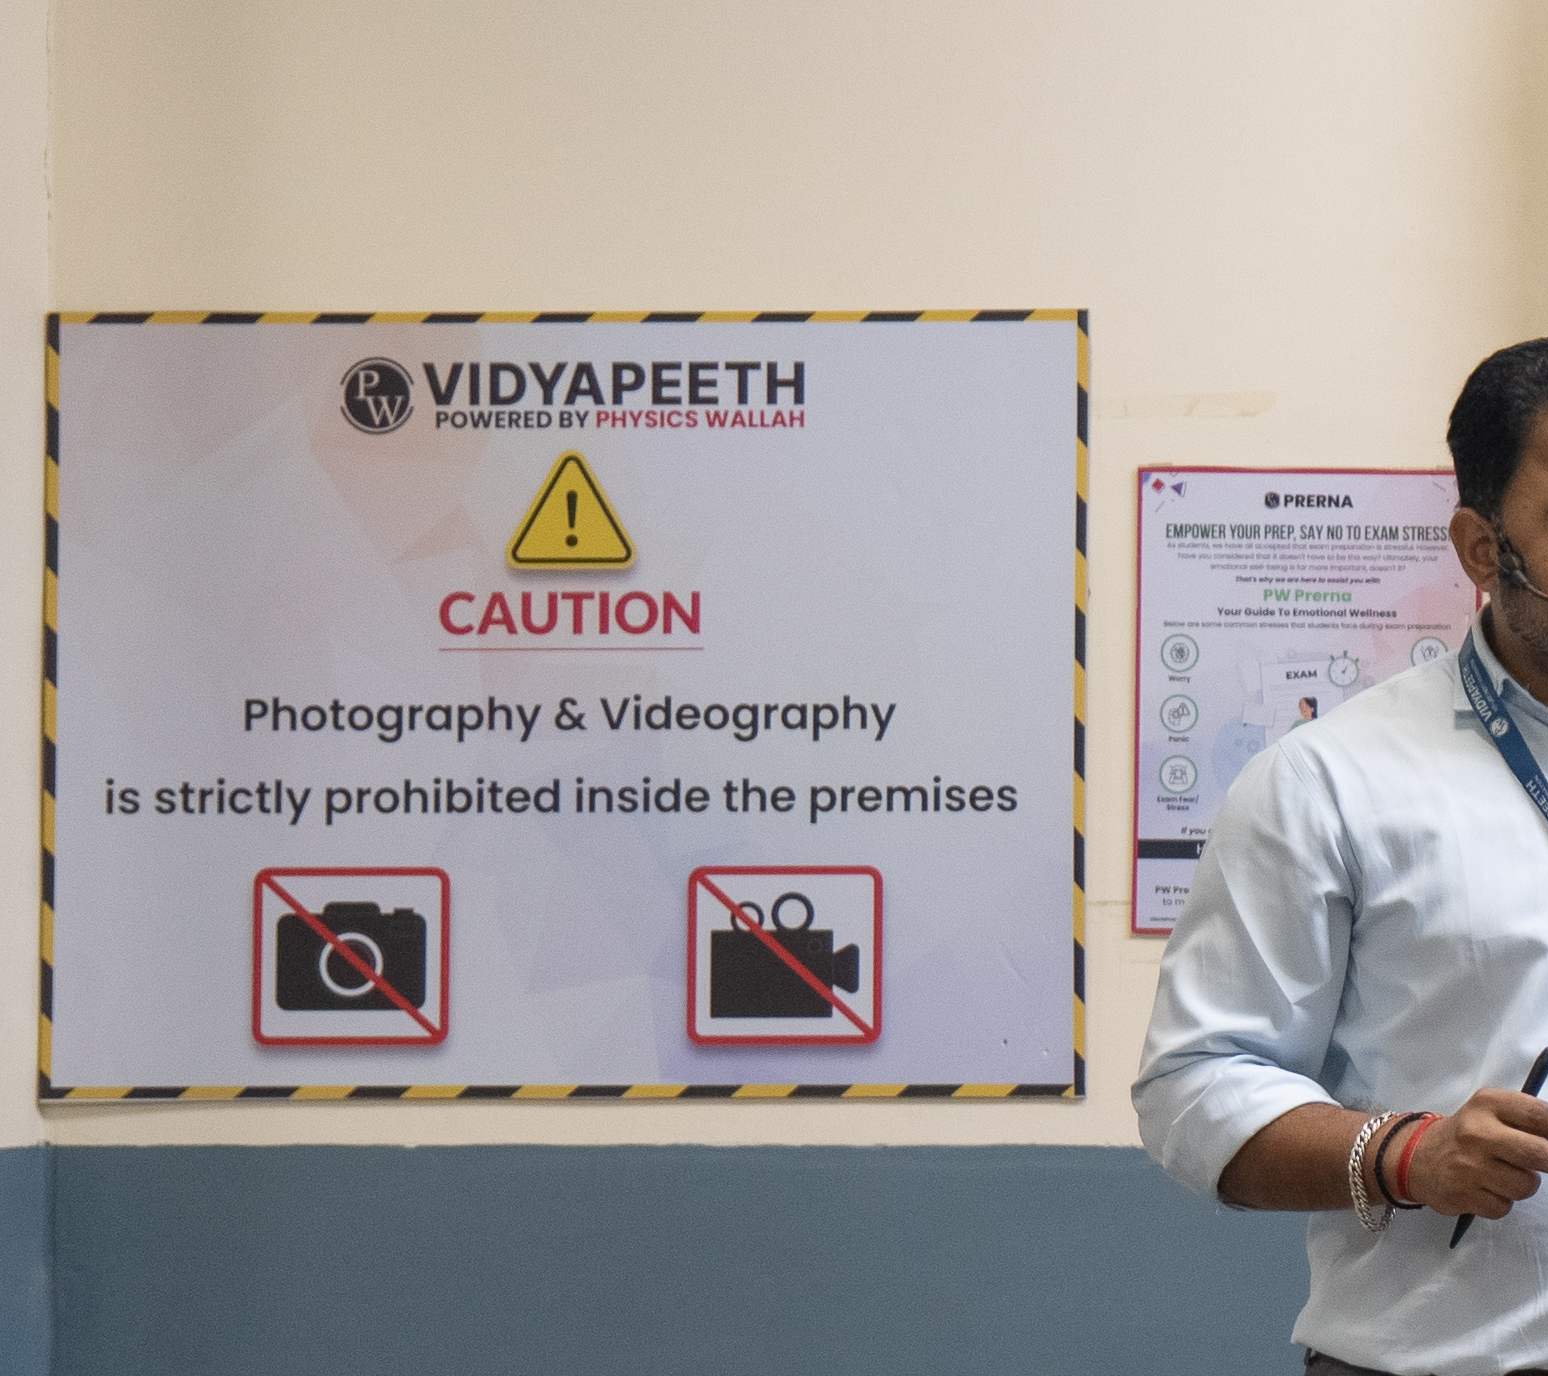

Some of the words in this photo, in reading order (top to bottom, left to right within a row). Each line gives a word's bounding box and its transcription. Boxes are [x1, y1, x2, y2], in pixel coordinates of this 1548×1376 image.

[423, 362, 804, 406] VIDYAPEETH
[436, 411, 552, 429] POWERED
[559, 410, 589, 428] BY
[596, 410, 698, 428] PHYSICS
[706, 410, 804, 428] WALLAH
[1284, 494, 1353, 508] PRERNA
[1166, 524, 1226, 539] EMPOWER
[1230, 524, 1260, 539] YOUR
[1300, 525, 1323, 540] SAY
[1327, 525, 1342, 540] NO
[1347, 525, 1361, 540] TO
[1365, 526, 1399, 541] EXAM
[1403, 524, 1452, 541] STRESS
[1264, 588, 1290, 602] PW
[1295, 589, 1352, 602] Prerna
[439, 591, 700, 635] CAUTION
[1218, 607, 1242, 616] Your
[1244, 607, 1275, 616] Guide
[1279, 608, 1290, 617] To
[1293, 608, 1346, 617] Emotional
[1349, 609, 1397, 618] Wellness
[1286, 670, 1317, 680] EXAM
[245, 696, 540, 743] Photography
[555, 698, 585, 730] &
[601, 694, 895, 742] Videography
[106, 778, 139, 814] is
[156, 778, 310, 825] strictly
[326, 778, 560, 826] prohibited
[576, 777, 710, 813] inside
[724, 778, 795, 812] the
[810, 776, 1017, 824] premises
